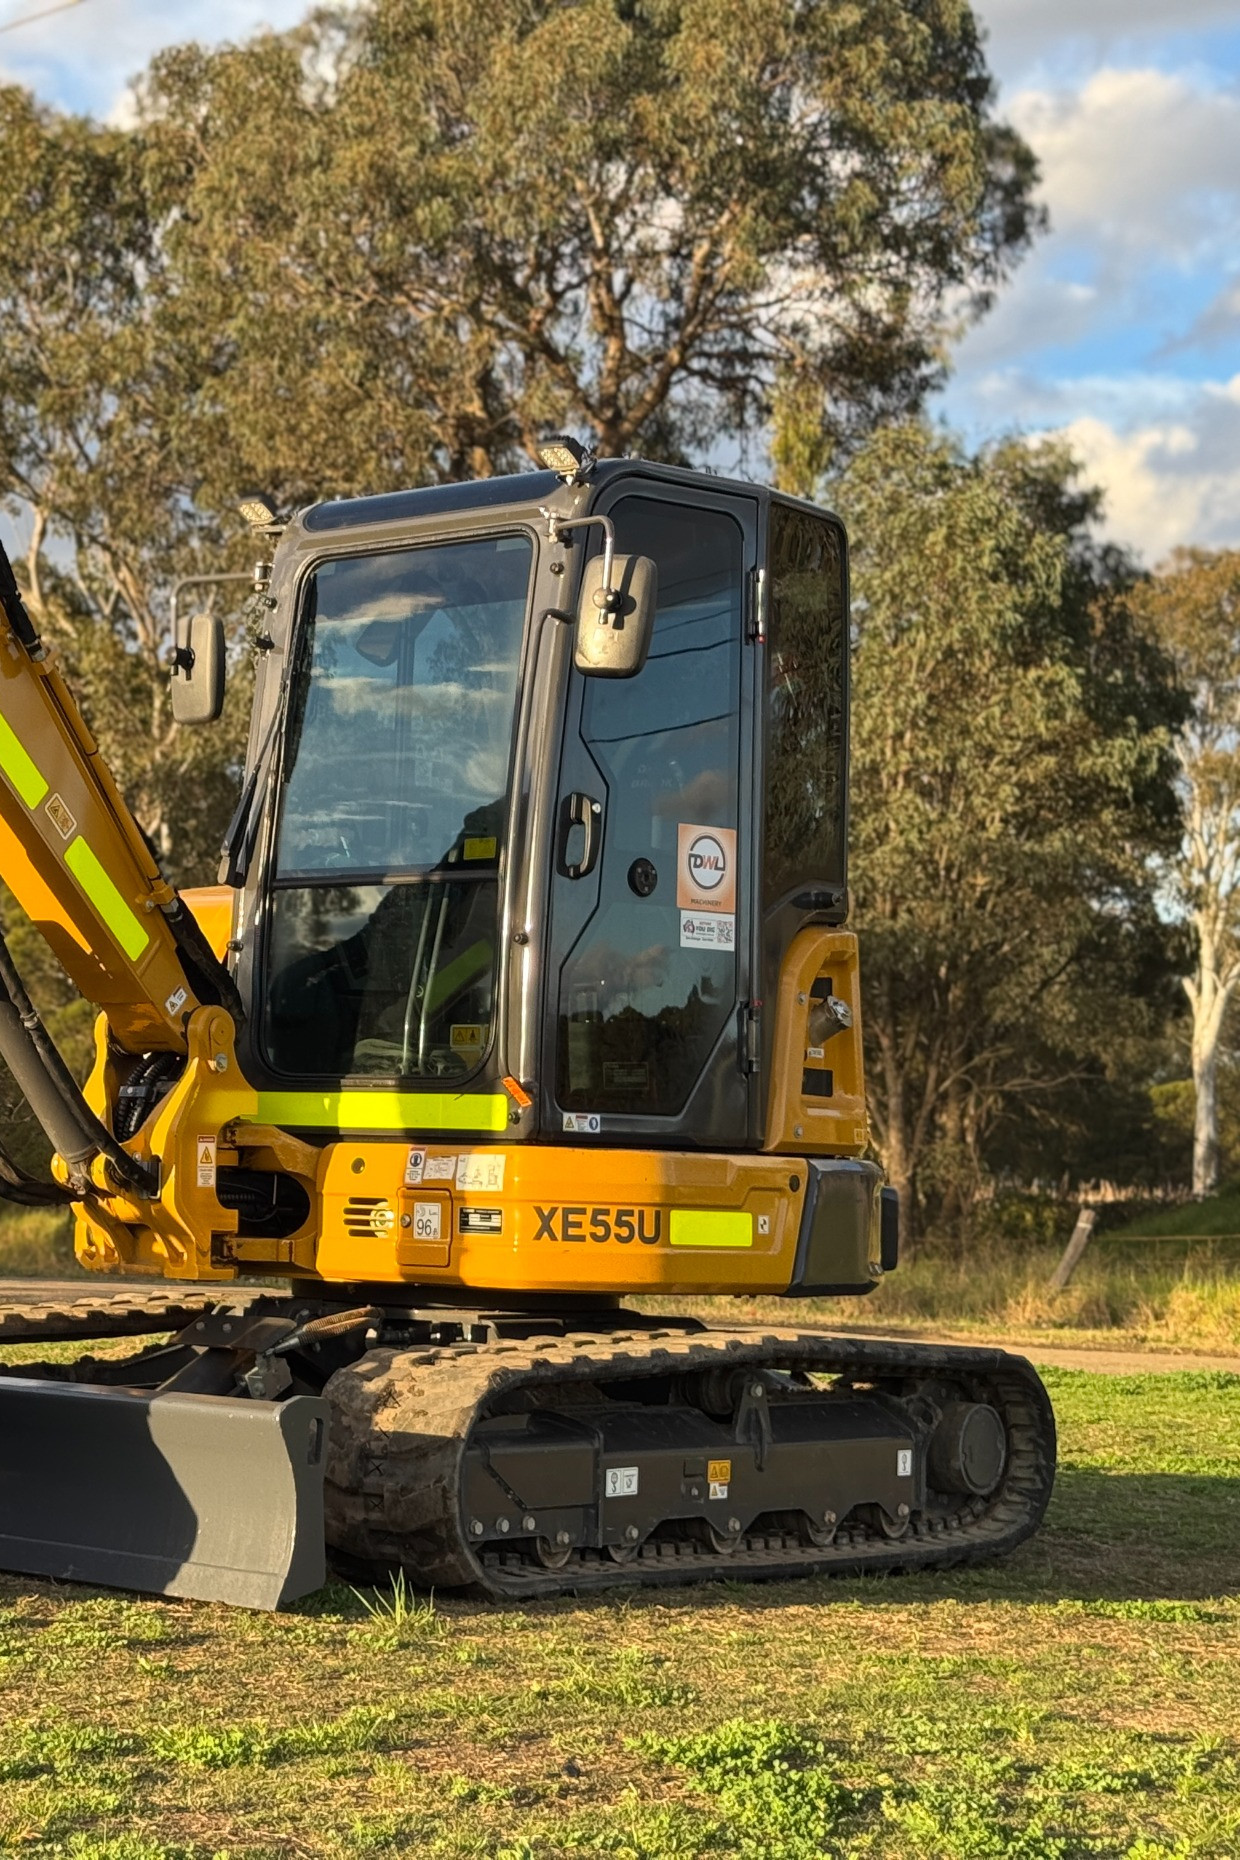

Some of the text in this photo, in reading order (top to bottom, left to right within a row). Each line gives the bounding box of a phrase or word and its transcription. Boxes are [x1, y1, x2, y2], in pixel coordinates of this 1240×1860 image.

[690, 898, 722, 907] MACHINERY
[416, 1218, 432, 1236] 96
[532, 1205, 661, 1245] XE55U
